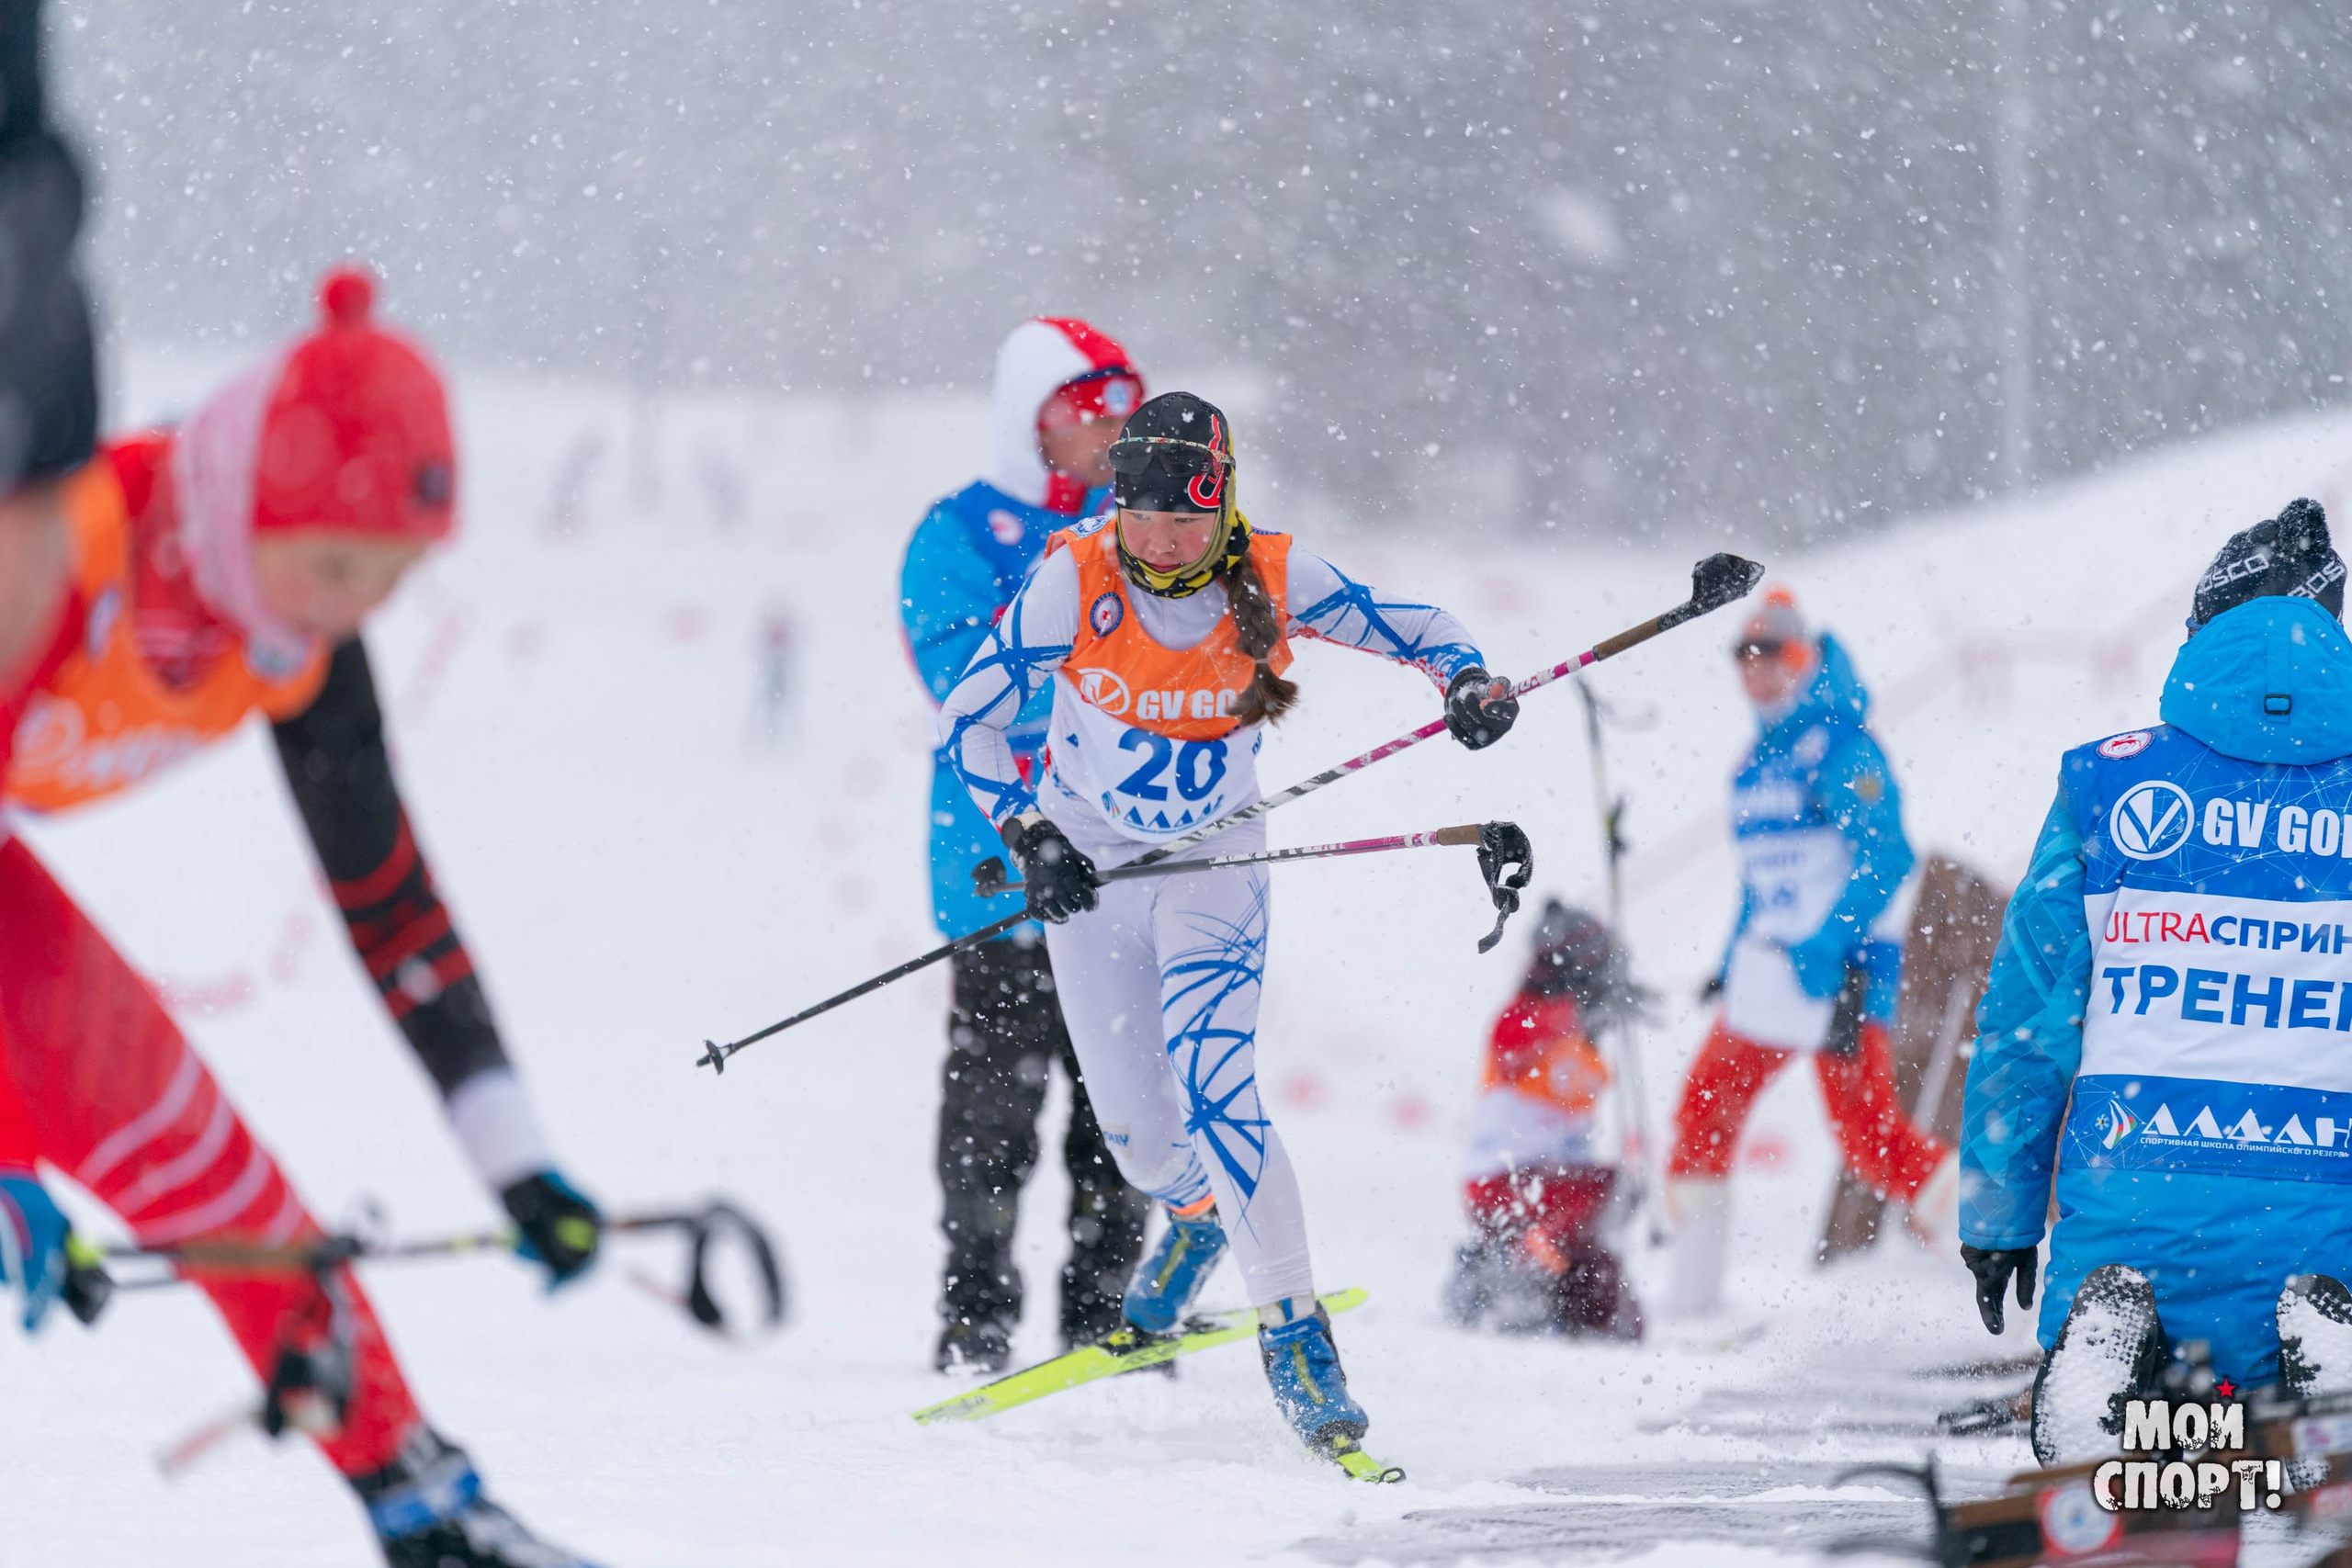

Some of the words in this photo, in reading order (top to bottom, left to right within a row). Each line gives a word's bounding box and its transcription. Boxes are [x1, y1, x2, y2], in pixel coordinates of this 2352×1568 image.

[1136, 690, 1184, 720] GV
[1191, 688, 1242, 719] GO
[1115, 728, 1228, 802] 20
[2202, 797, 2269, 849] GV
[2140, 1136, 2199, 1147] СПОРТИВНАЯ
[2200, 1141, 2234, 1150] ШКОЛА
[2236, 1145, 2312, 1156] ОЛИМПИЙСКОГО
